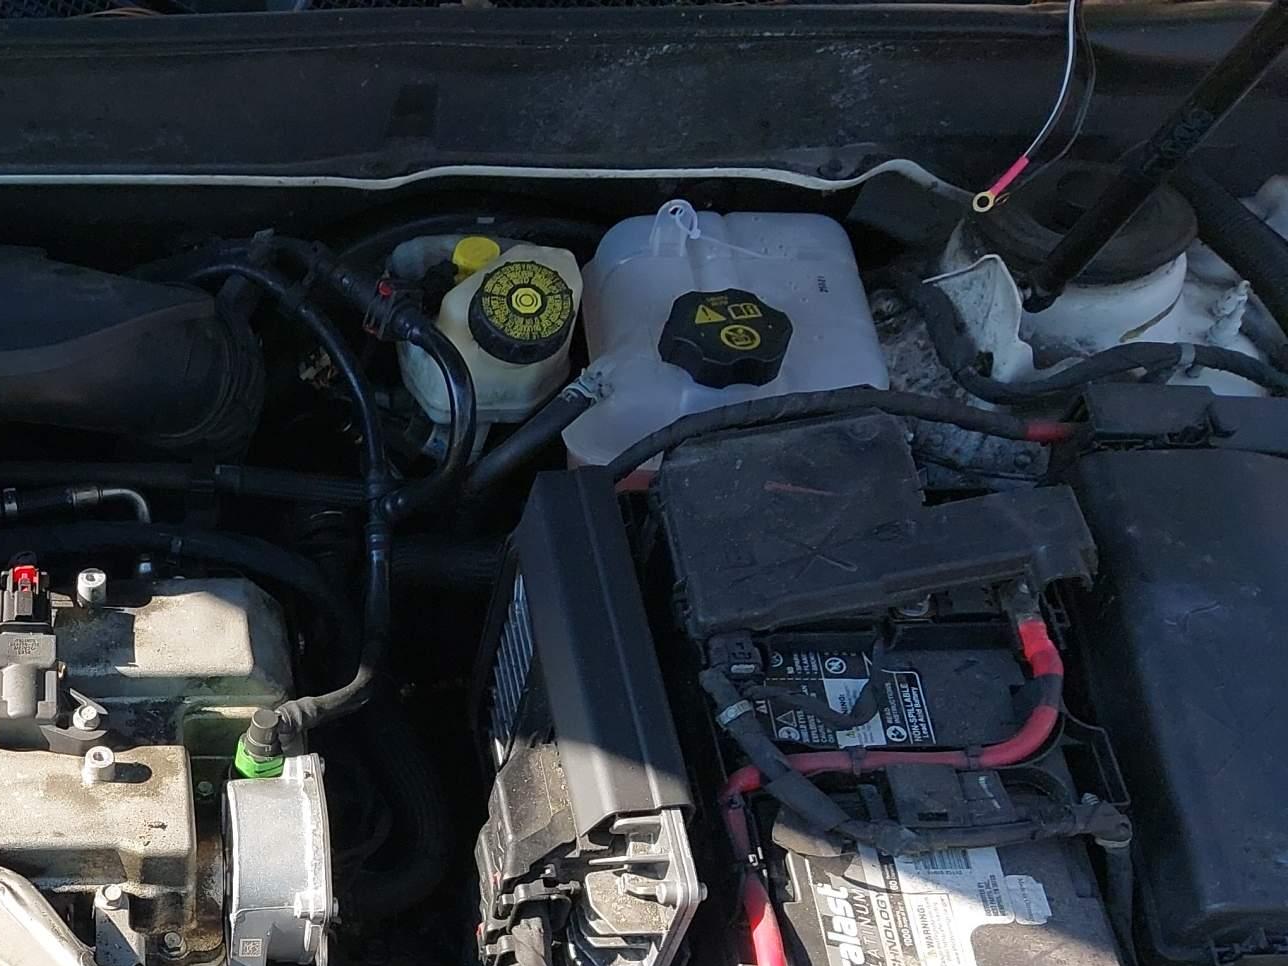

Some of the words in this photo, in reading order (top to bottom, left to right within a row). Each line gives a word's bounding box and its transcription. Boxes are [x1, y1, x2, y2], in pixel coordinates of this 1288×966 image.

[900, 683, 923, 742] NON-SPILLABLE
[900, 928, 914, 947] 1000
[917, 904, 934, 950] WARNING:
